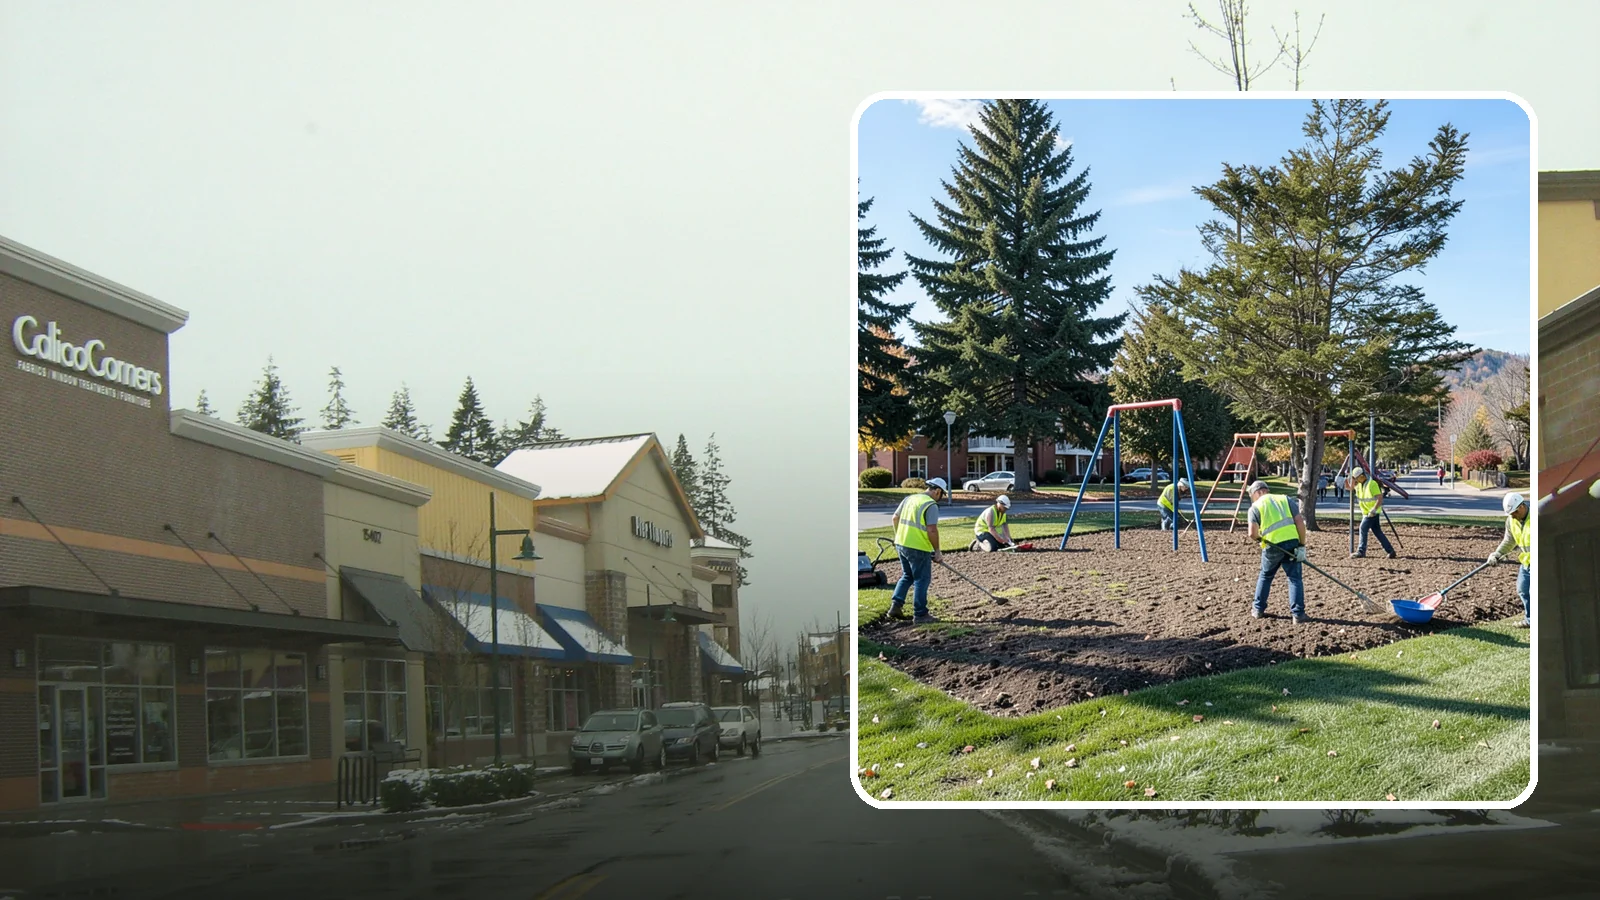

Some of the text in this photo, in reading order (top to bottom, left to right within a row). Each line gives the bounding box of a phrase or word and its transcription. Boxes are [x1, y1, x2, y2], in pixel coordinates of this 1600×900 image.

[17, 360, 47, 377] FABRICS
[51, 370, 78, 386] WINDOW
[79, 378, 116, 398] TREATMENTS
